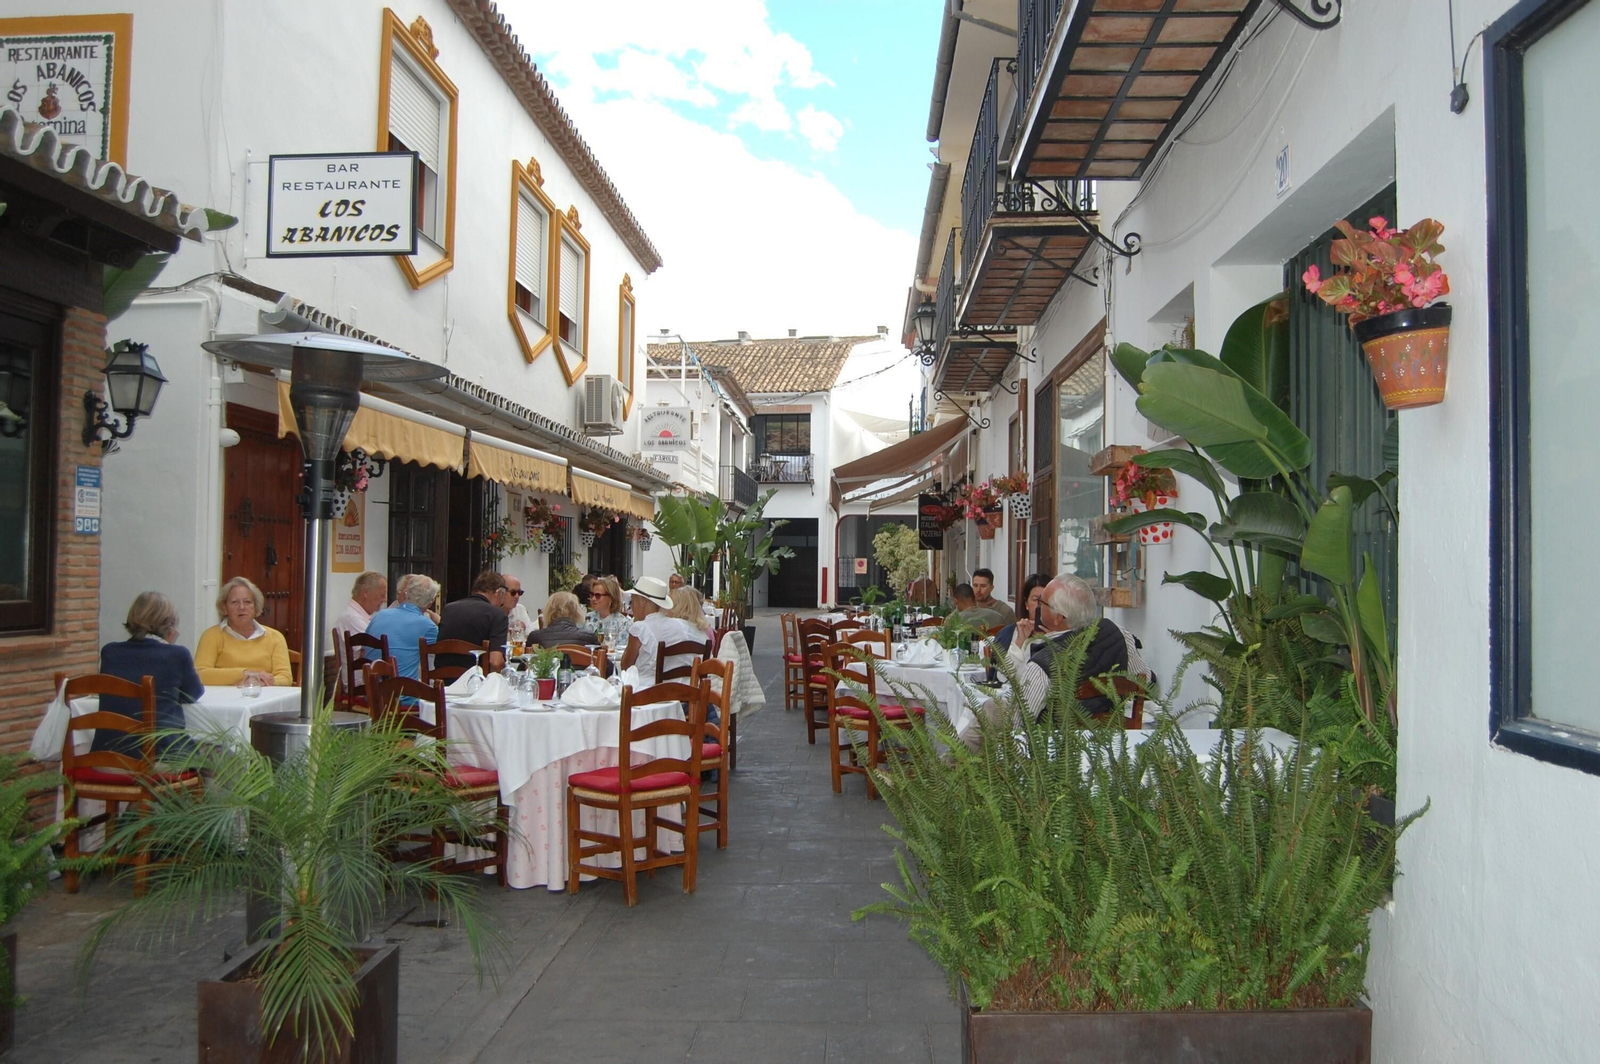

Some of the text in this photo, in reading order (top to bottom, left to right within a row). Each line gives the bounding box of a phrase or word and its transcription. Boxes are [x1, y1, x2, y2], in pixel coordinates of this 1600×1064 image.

[8, 45, 98, 64] RESTAURANTE
[37, 62, 97, 113] ABANICOS
[327, 163, 359, 173] BAR
[282, 179, 401, 191] RESTAURANTE
[318, 199, 366, 218] LOS
[281, 223, 401, 245] ABANICOS
[643, 410, 687, 423] RESTAURANTE
[920, 530, 942, 538] PIZZERIA
